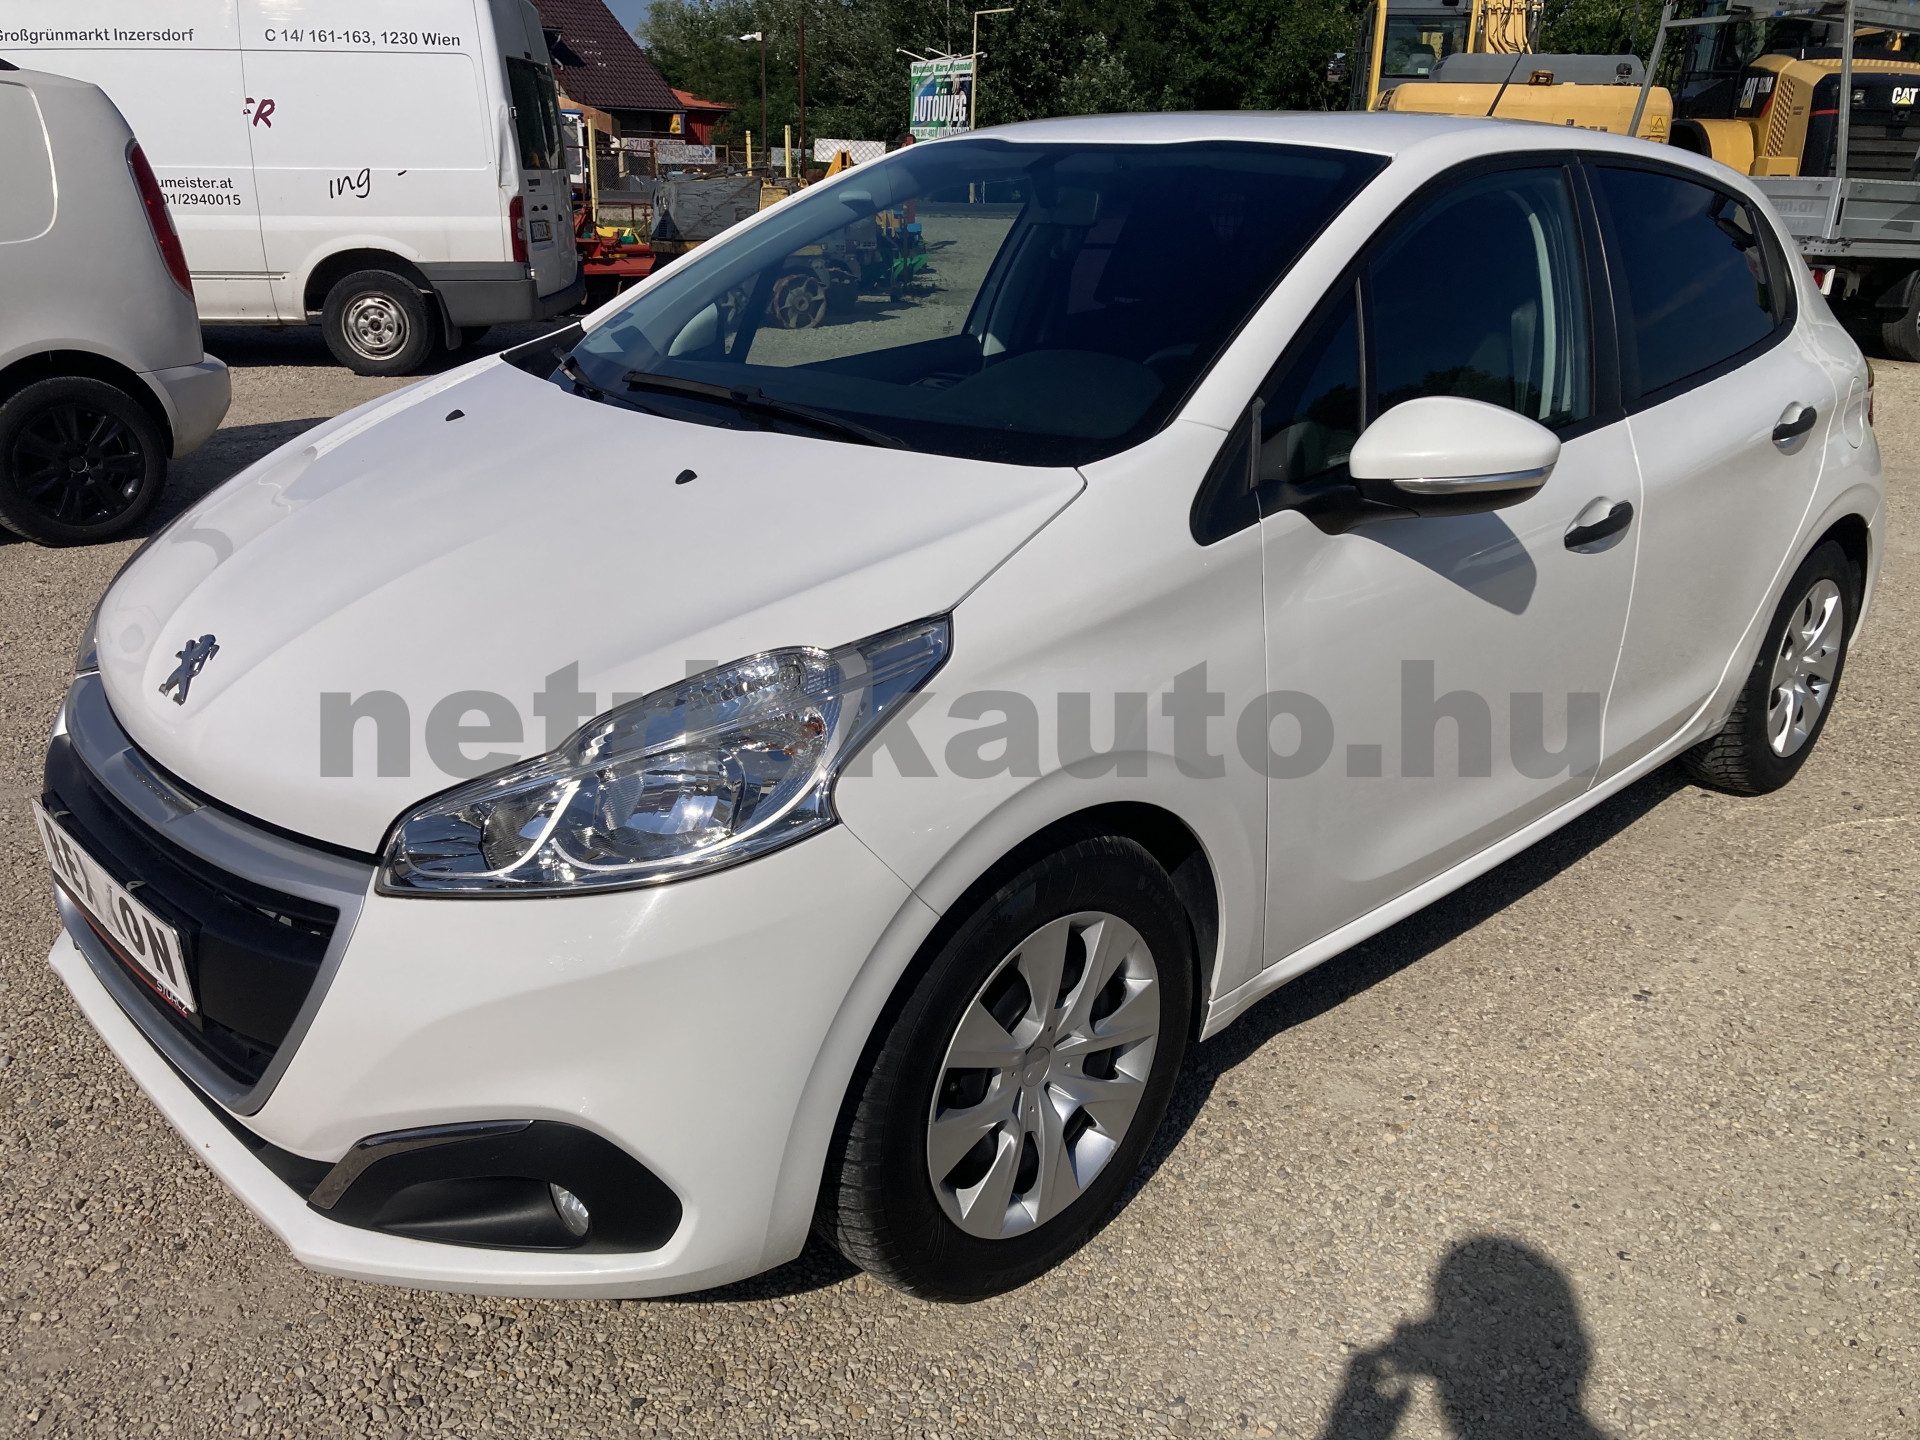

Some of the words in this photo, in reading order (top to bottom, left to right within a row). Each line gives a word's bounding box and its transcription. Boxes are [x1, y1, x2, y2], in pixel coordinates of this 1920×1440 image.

[114, 28, 194, 41] Inzersdorf
[264, 29, 276, 42] C
[281, 29, 304, 42] 14/
[309, 30, 376, 45] 161-163,
[381, 32, 418, 44] 1230
[422, 32, 461, 46] Wien
[1891, 87, 1918, 104] CAT
[913, 87, 967, 122] AUTÓÜVEG
